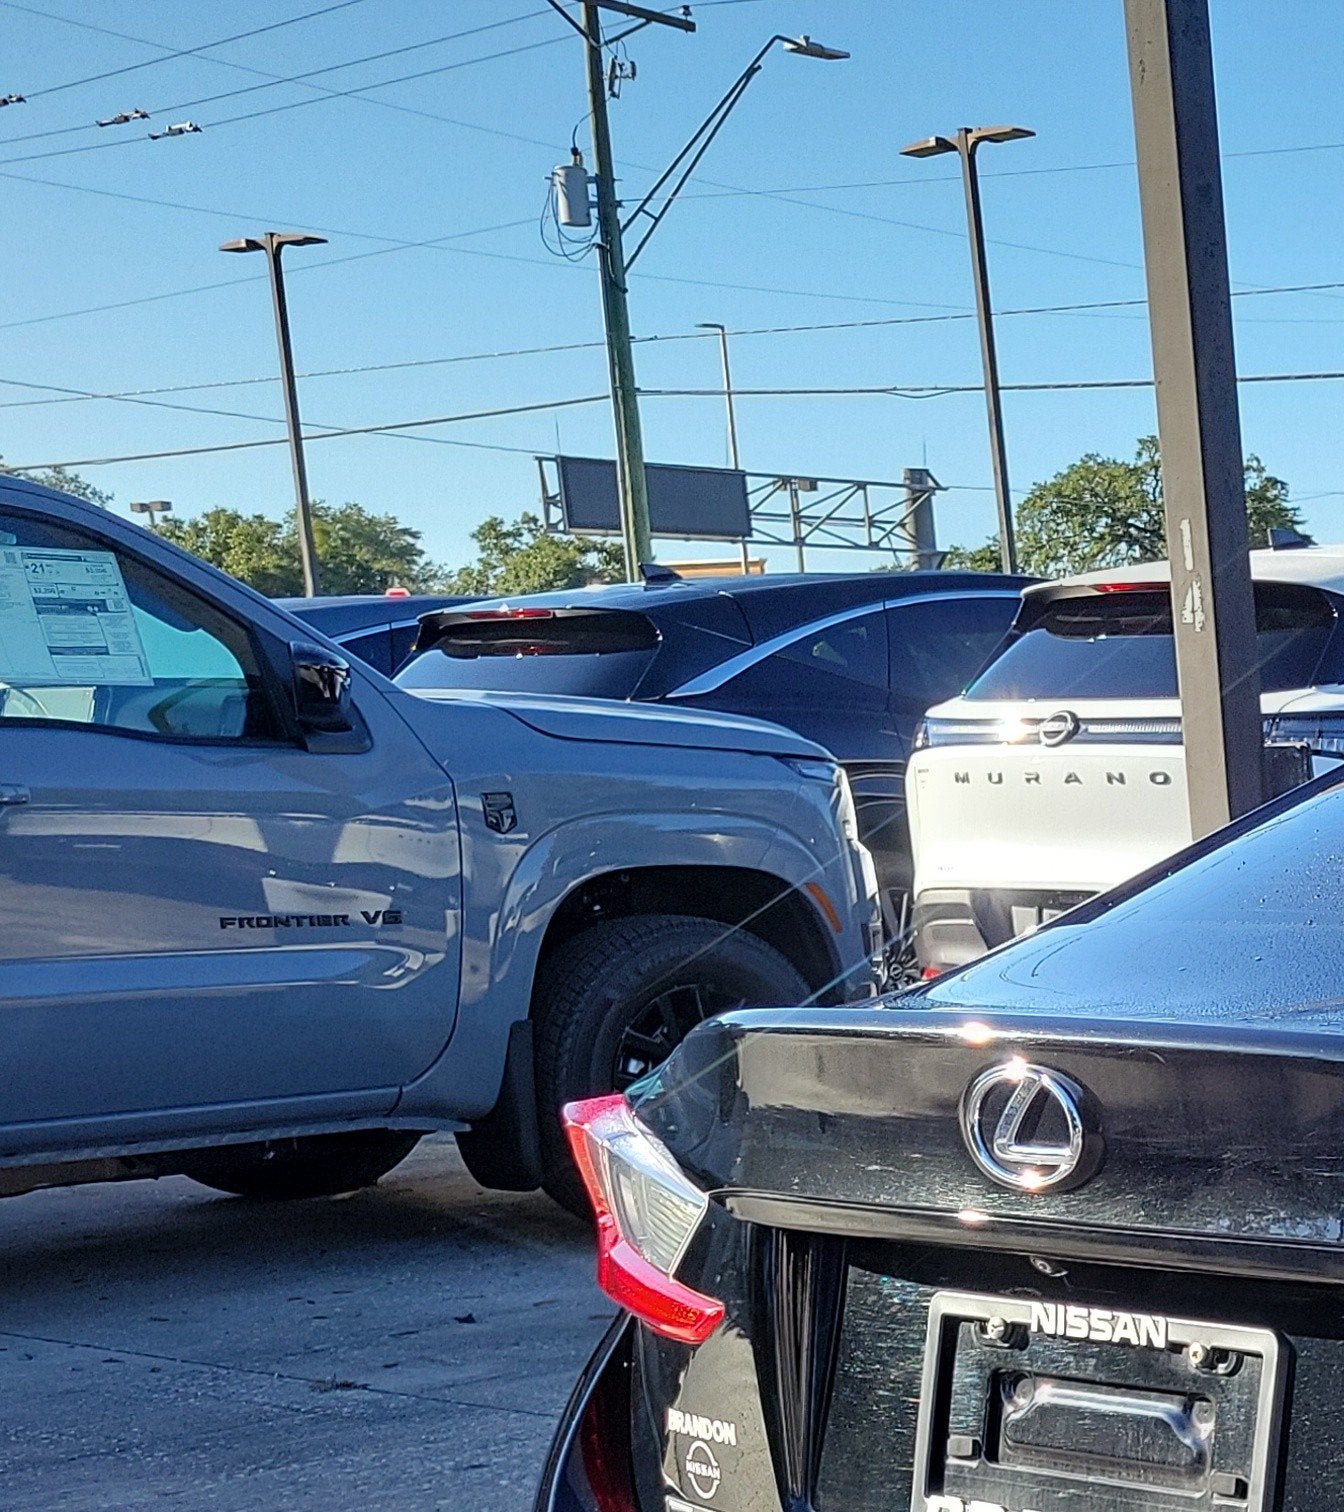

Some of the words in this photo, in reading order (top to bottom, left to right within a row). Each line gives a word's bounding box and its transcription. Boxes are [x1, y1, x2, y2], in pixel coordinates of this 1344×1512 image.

[30, 562, 45, 574] 21
[954, 771, 1172, 786] MURANO
[219, 914, 351, 930] FRONTIER
[360, 909, 404, 925] V6
[1030, 1302, 1169, 1349] NISSAN
[668, 1407, 737, 1446] BRANDON
[685, 1459, 721, 1480] NISSAN
